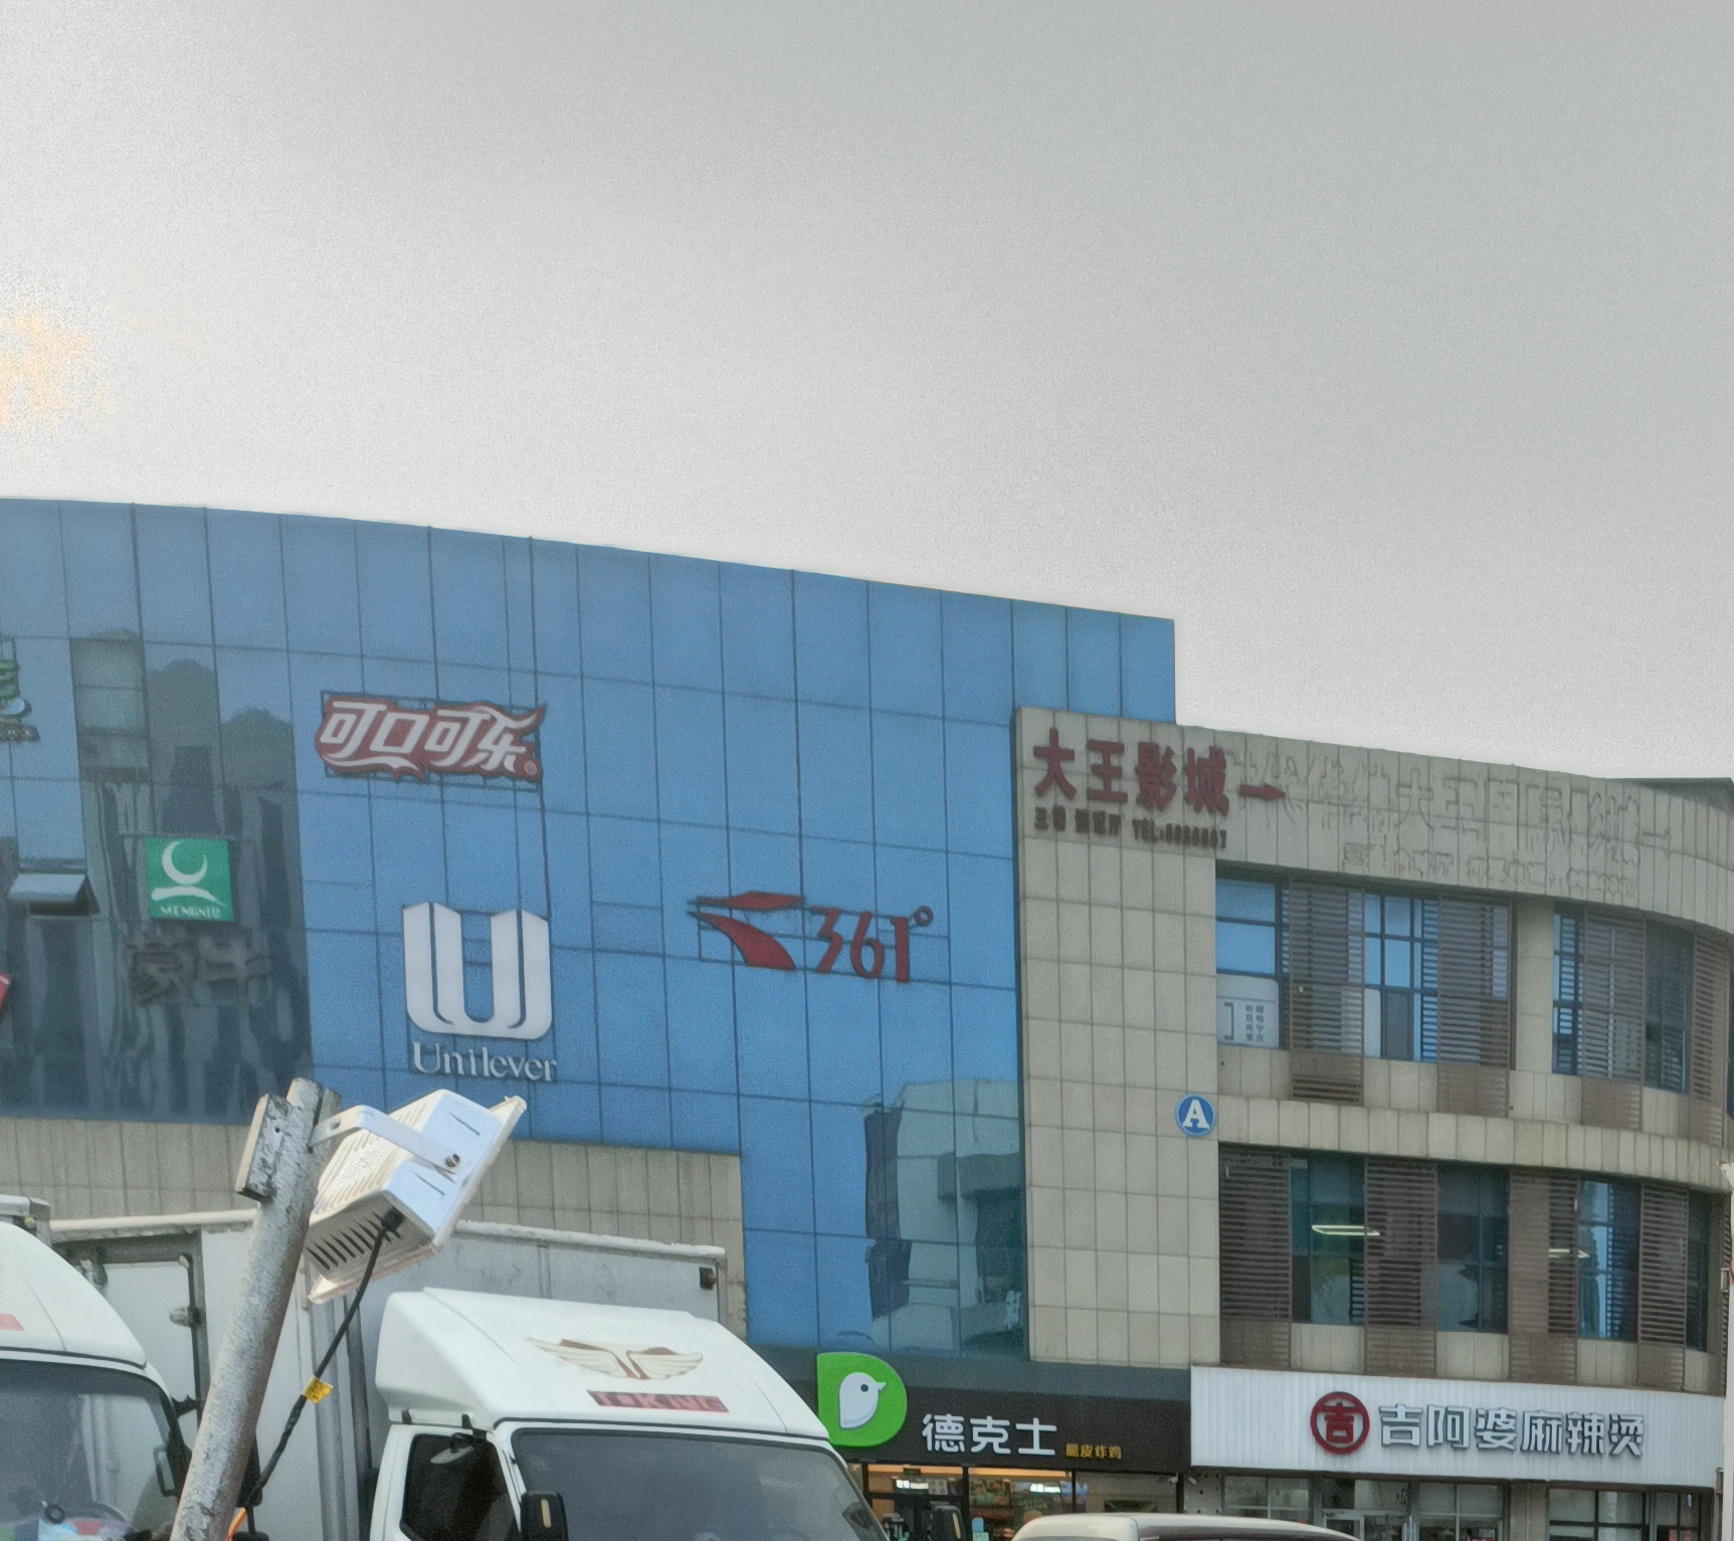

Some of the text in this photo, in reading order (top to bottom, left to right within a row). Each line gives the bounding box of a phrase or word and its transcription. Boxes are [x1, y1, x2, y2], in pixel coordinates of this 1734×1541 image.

[319, 699, 542, 774] 可口可乐
[1033, 727, 1230, 817] 大王影城
[412, 1041, 558, 1083] Unilever
[922, 1413, 1058, 1457] 德克士
[1378, 1402, 1646, 1458] 吉阿婆麻辣烫
